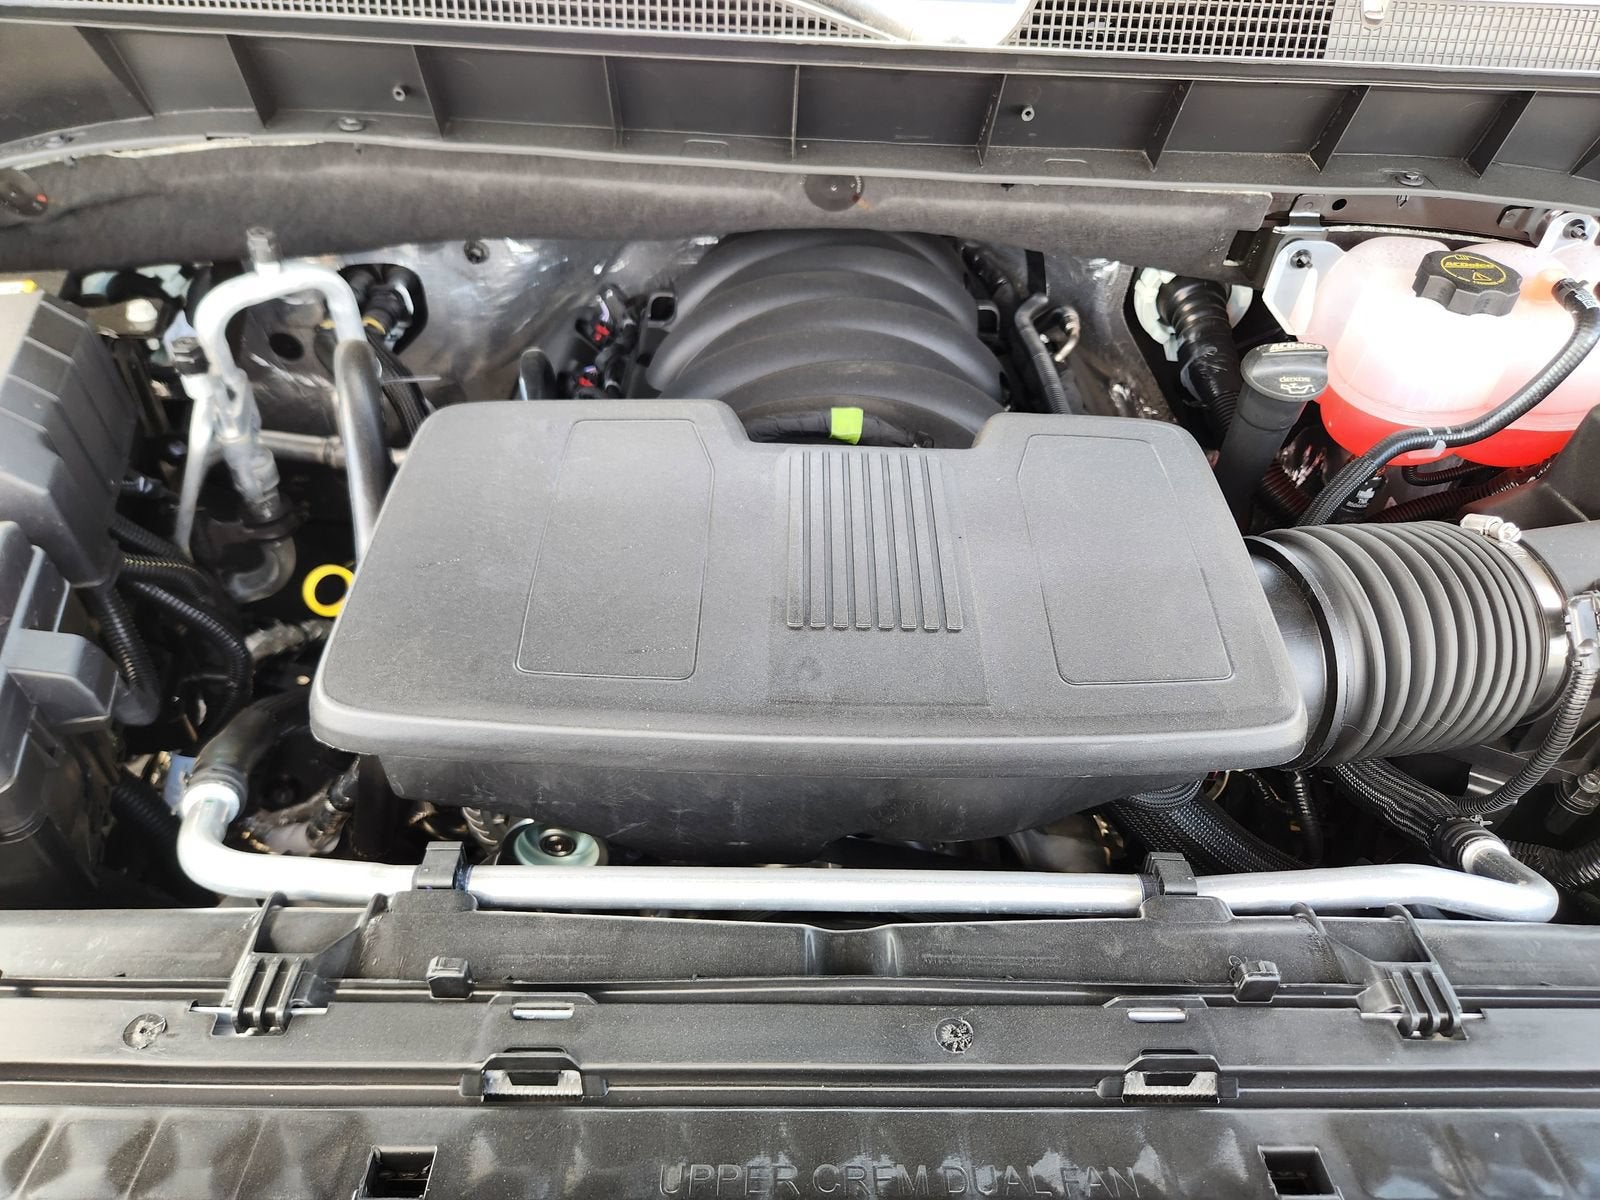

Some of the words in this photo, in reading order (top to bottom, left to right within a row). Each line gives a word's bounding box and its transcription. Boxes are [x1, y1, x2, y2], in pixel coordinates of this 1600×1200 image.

[658, 1163, 801, 1197] UPPER
[812, 1163, 930, 1196] CRFM
[942, 1164, 1053, 1196] DUAL
[1060, 1165, 1140, 1199] FAN
